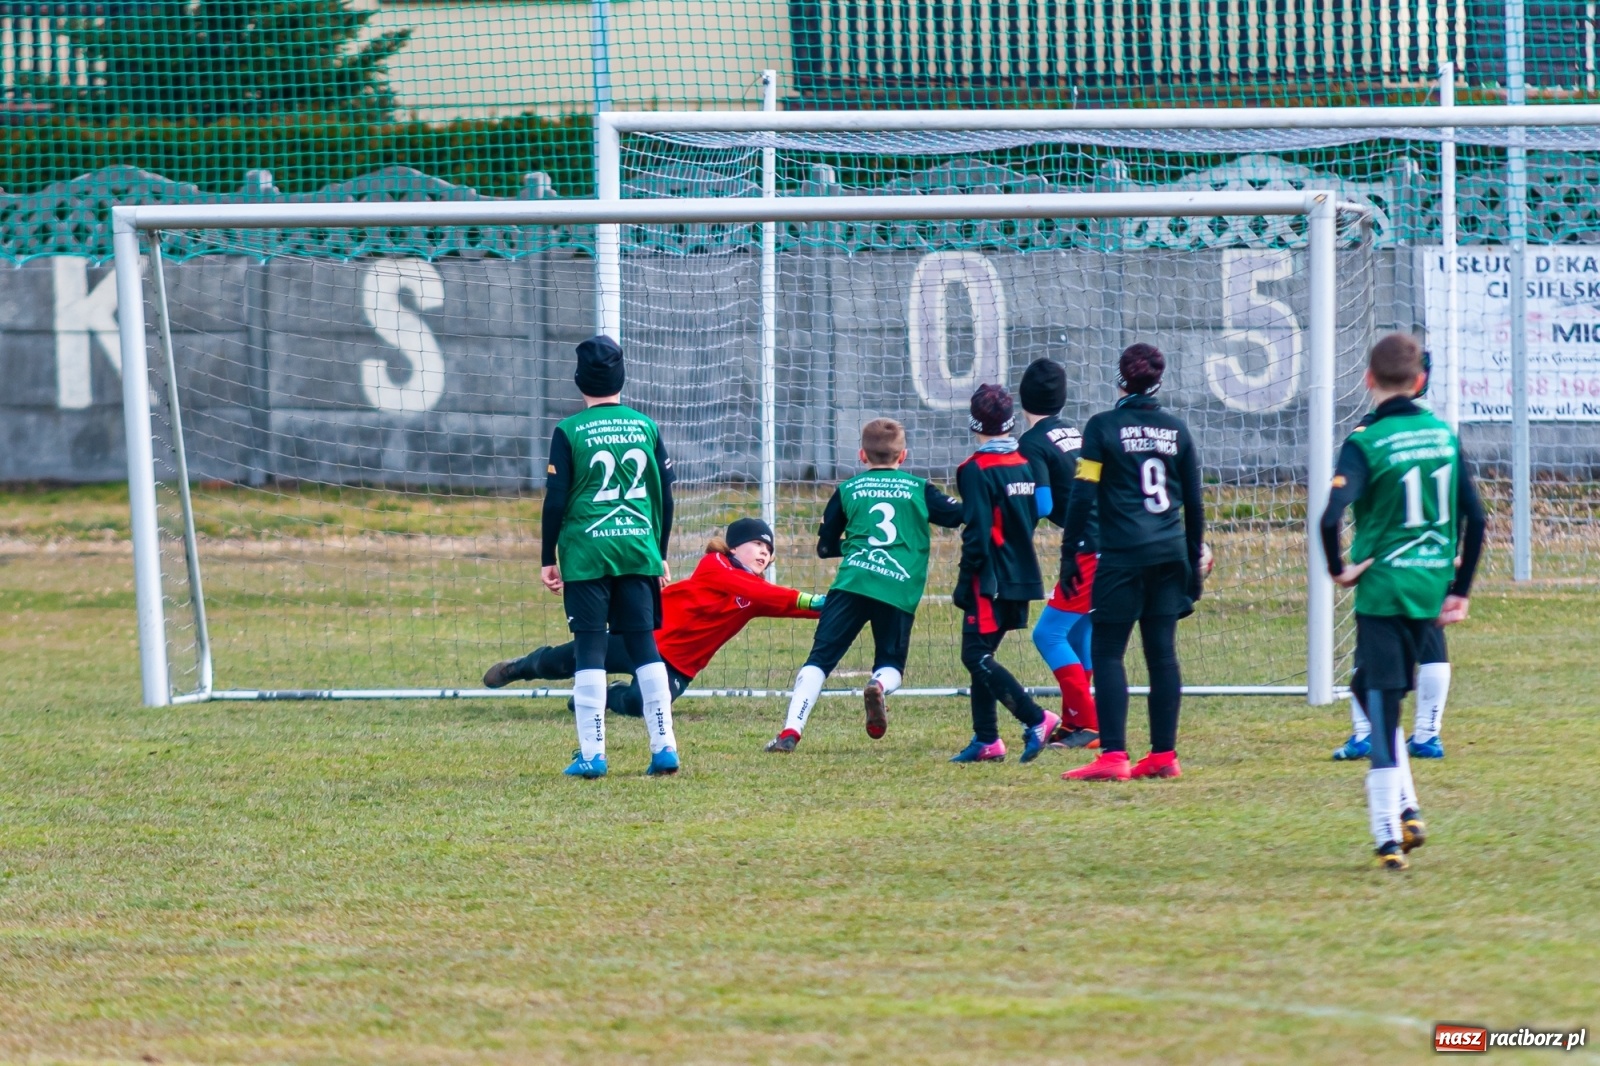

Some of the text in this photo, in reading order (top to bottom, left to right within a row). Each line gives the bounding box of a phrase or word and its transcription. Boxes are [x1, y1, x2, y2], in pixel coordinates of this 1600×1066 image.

[1487, 281, 1600, 298] CISIELSK
[585, 431, 647, 447] TWORKÓW
[1143, 426, 1179, 441] TALENT
[589, 448, 648, 502] 22
[1142, 457, 1171, 514] 9
[851, 487, 914, 500] TWORKÓW
[1400, 463, 1453, 528] 11
[867, 502, 897, 546] 3
